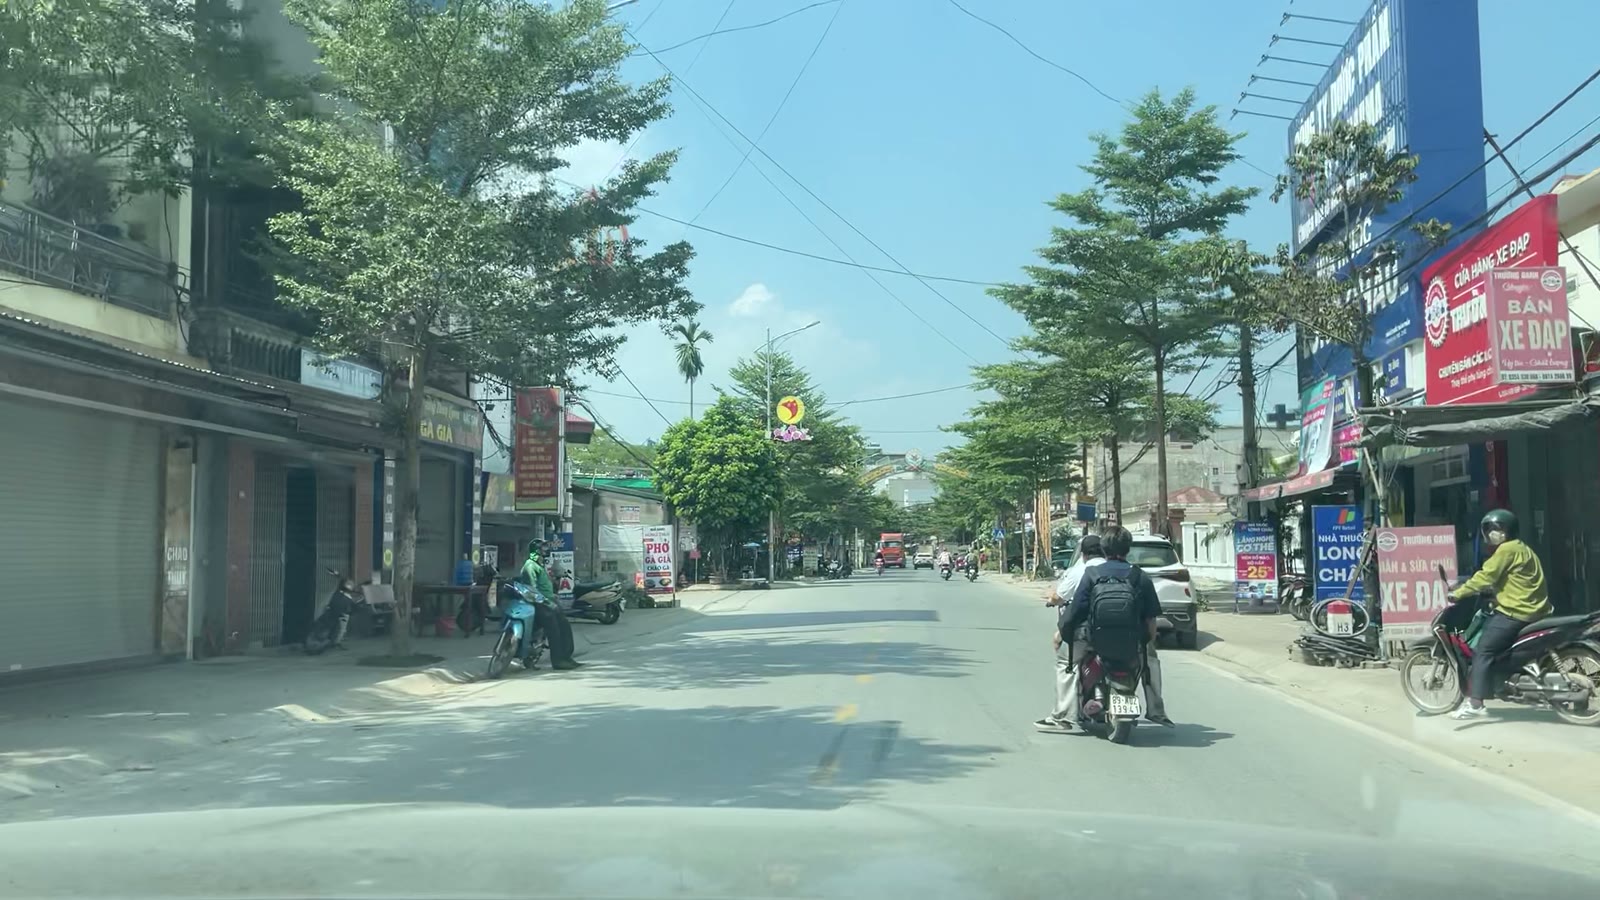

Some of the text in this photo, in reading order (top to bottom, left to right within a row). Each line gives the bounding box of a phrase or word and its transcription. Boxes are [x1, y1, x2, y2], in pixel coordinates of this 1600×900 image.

[1454, 232, 1531, 289] CỬA HÀNG XE ĐẠP
[1508, 296, 1553, 314] BÁN
[1499, 319, 1567, 357] XE ĐẠP
[1472, 348, 1485, 367] CÁC
[646, 538, 670, 554] PHỞ
[1318, 532, 1337, 543] NHÀ
[645, 554, 671, 564] GÀ GIÀ
[1401, 564, 1408, 573] &
[1410, 556, 1429, 573] SỬA
[1382, 581, 1409, 612] XE
[1338, 623, 1349, 632] H3
